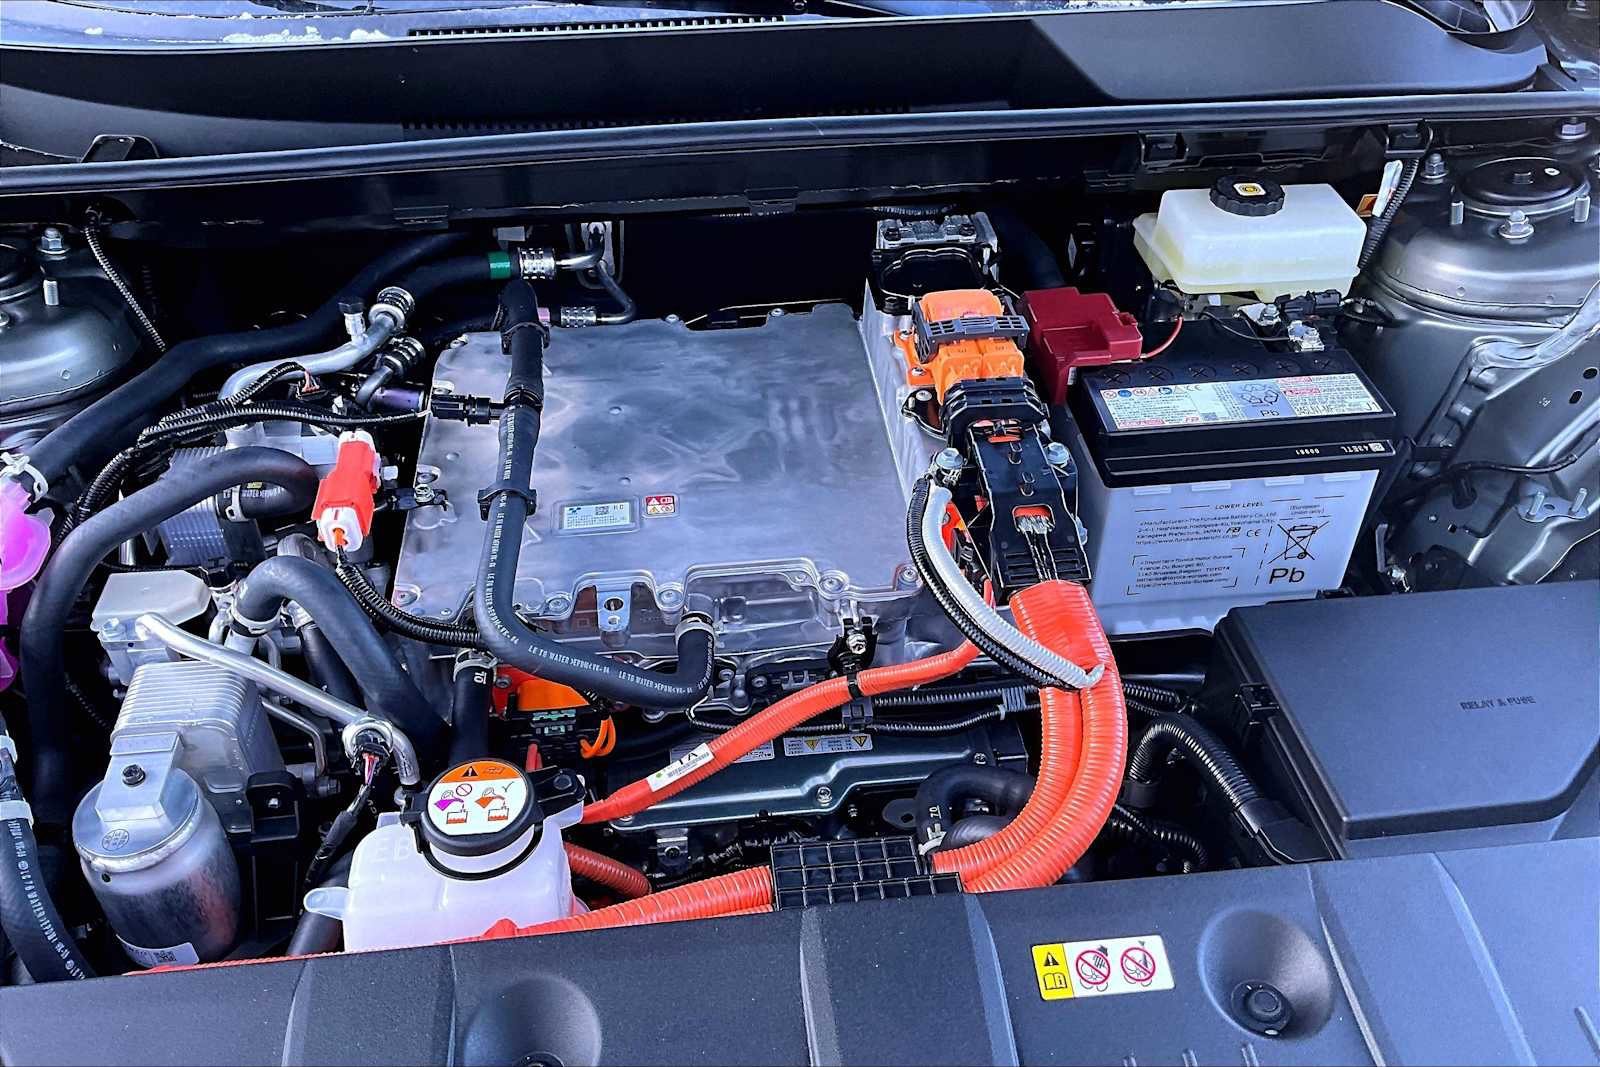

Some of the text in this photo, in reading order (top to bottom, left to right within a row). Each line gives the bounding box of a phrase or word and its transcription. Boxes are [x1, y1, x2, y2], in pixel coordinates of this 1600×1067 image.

[1215, 502, 1240, 510] LOWER
[1268, 567, 1305, 585] Pb
[549, 651, 570, 664] WATER
[636, 676, 654, 688] WATER
[1459, 699, 1495, 711] RELAY
[1506, 695, 1537, 705] FUSE
